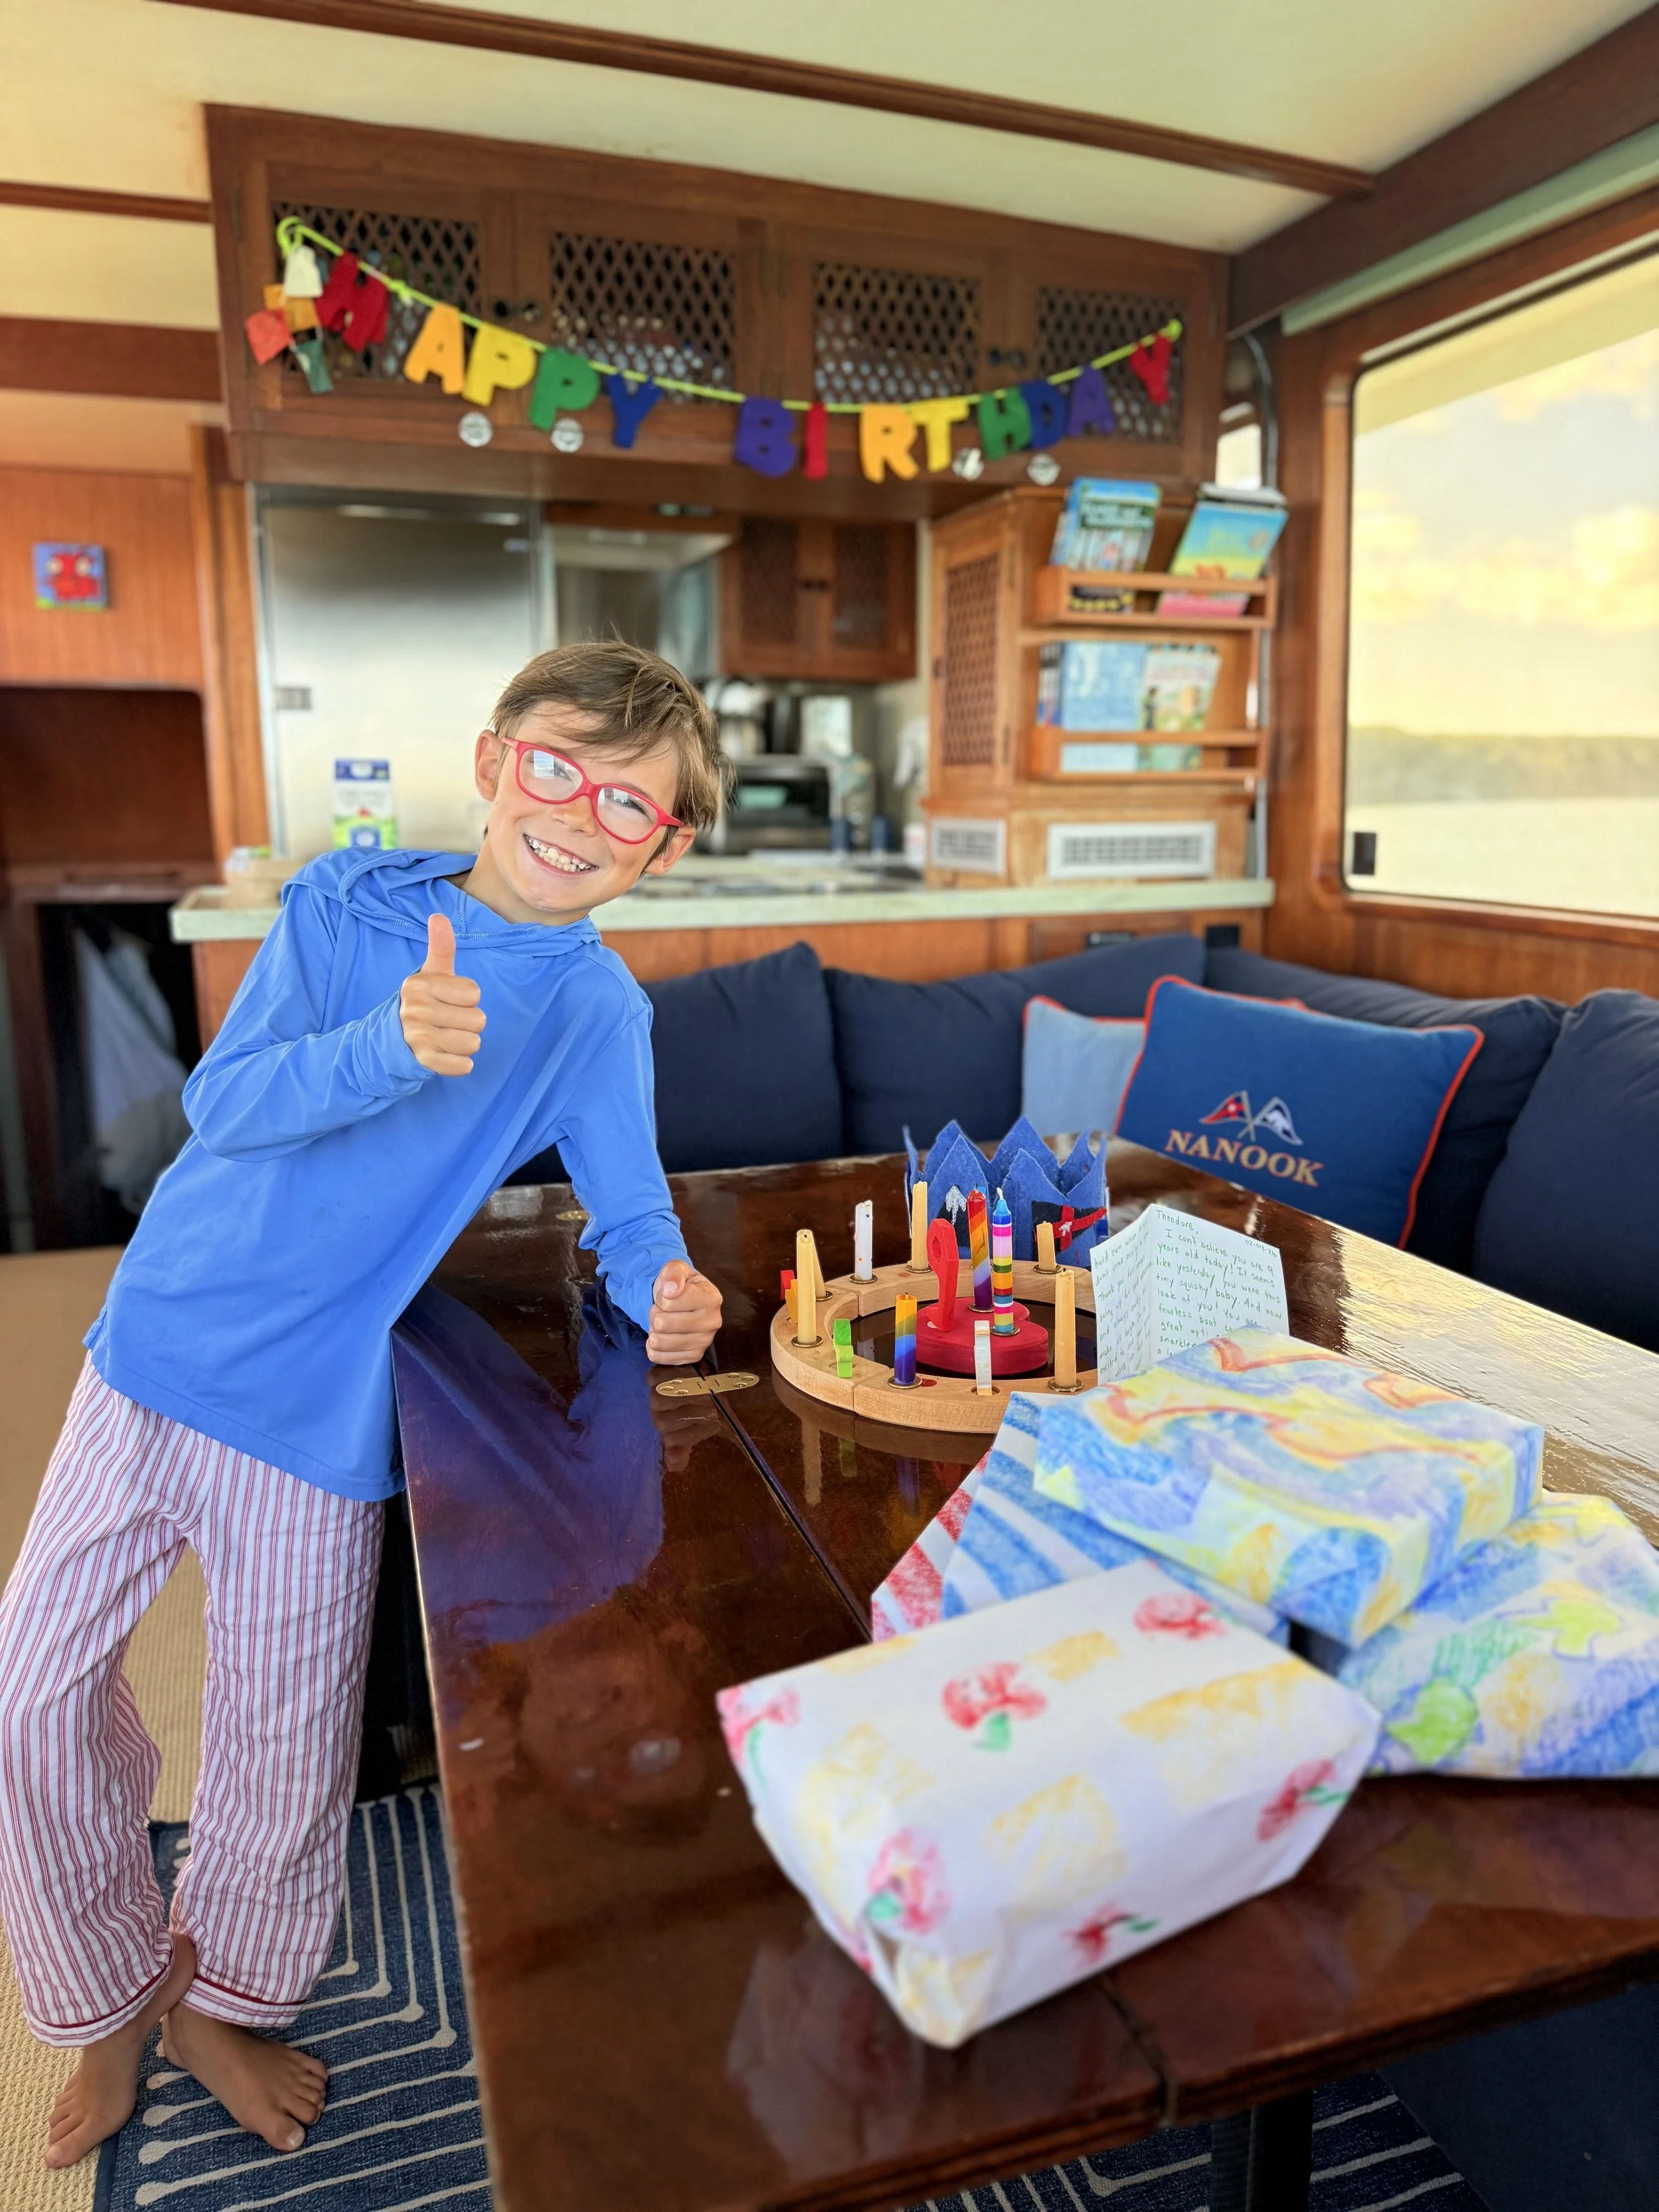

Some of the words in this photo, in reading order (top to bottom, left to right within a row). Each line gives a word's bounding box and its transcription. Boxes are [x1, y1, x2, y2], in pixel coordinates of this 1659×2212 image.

[315, 250, 664, 449] HAPPY
[735, 331, 1172, 482] BIRTHDAY
[1165, 1128, 1324, 1187] NANOOK
[1156, 1210, 1198, 1234] Theodore,
[1094, 1250, 1108, 1268] hard
[1165, 1228, 1173, 1238] I
[1179, 1235, 1196, 1246] can't
[1201, 1238, 1228, 1256] believe
[1232, 1254, 1246, 1265] you
[1251, 1262, 1263, 1272] are
[1267, 1266, 1274, 1276] 9
[1157, 1242, 1179, 1254] years
[1185, 1248, 1198, 1259] old
[1251, 1273, 1275, 1288] seems
[1156, 1256, 1171, 1268] like
[1177, 1264, 1215, 1289] yesterday
[1223, 1279, 1236, 1289] you
[1241, 1286, 1260, 1295] were
[1265, 1290, 1281, 1303] this
[1098, 1284, 1114, 1301] Thank
[1156, 1273, 1174, 1289] tiny
[1180, 1280, 1208, 1298] squishy
[1244, 1298, 1261, 1312] And
[1266, 1309, 1282, 1319] now
[1157, 1288, 1176, 1299] look
[1183, 1293, 1190, 1303] at
[1099, 1309, 1113, 1322] being
[1158, 1303, 1192, 1318] fearless
[1198, 1314, 1216, 1327] boat
[1161, 1320, 1183, 1332] great
[1100, 1323, 1109, 1341] and
[1100, 1345, 1112, 1359] make
[1100, 1351, 1117, 1374] excited
